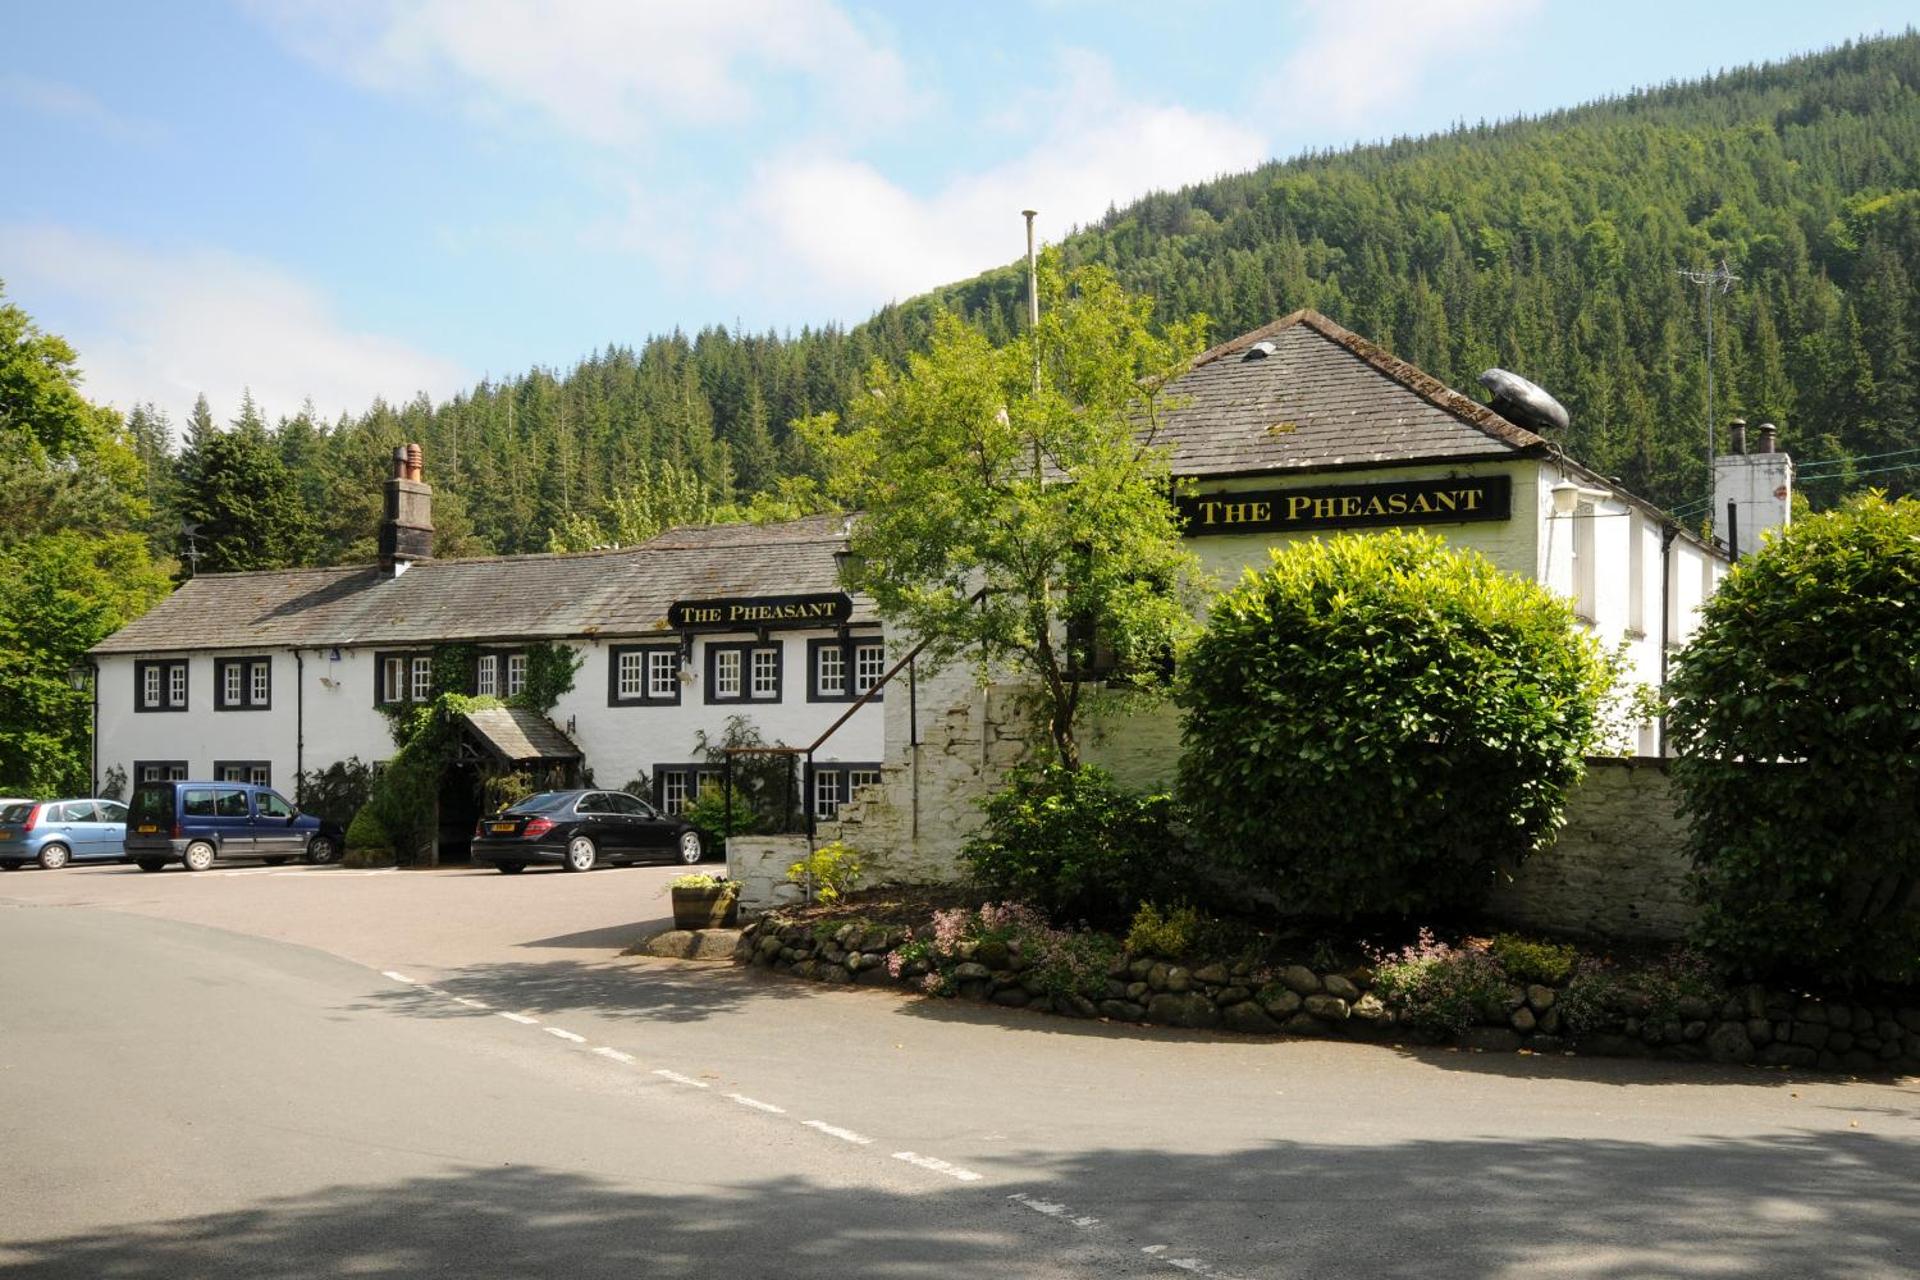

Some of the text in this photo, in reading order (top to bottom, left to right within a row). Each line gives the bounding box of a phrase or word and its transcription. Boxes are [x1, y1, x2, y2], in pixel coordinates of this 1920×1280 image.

[1198, 489, 1483, 525] THE PHEASANT
[680, 602, 836, 623] THE PHEASANT
